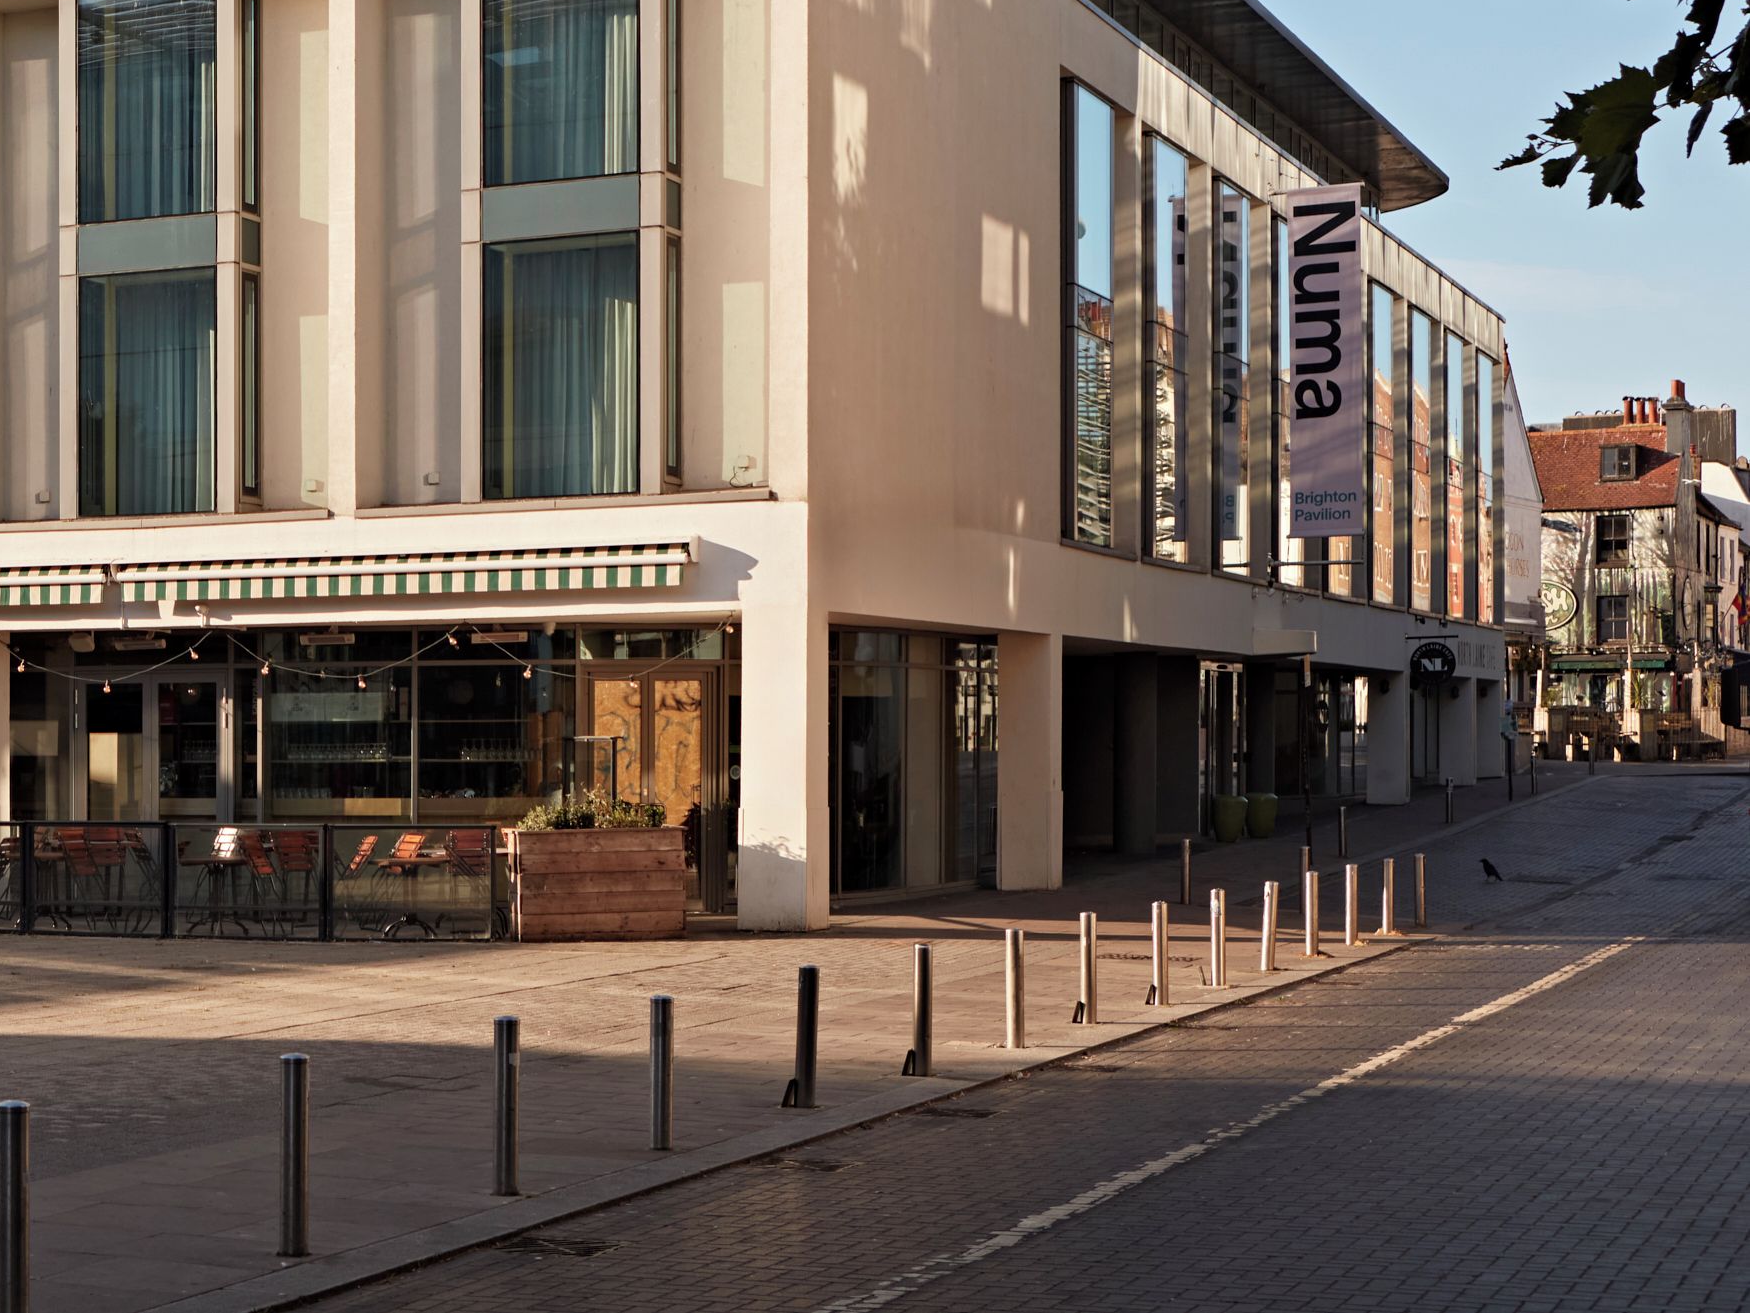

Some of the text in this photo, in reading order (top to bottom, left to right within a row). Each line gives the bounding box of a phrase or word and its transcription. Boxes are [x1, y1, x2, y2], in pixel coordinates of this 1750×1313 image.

[1293, 200, 1357, 420] Numa
[1294, 490, 1357, 506] Brighton
[1294, 508, 1351, 522] Pavilion
[1541, 587, 1568, 614] SH
[1419, 658, 1448, 672] NL
